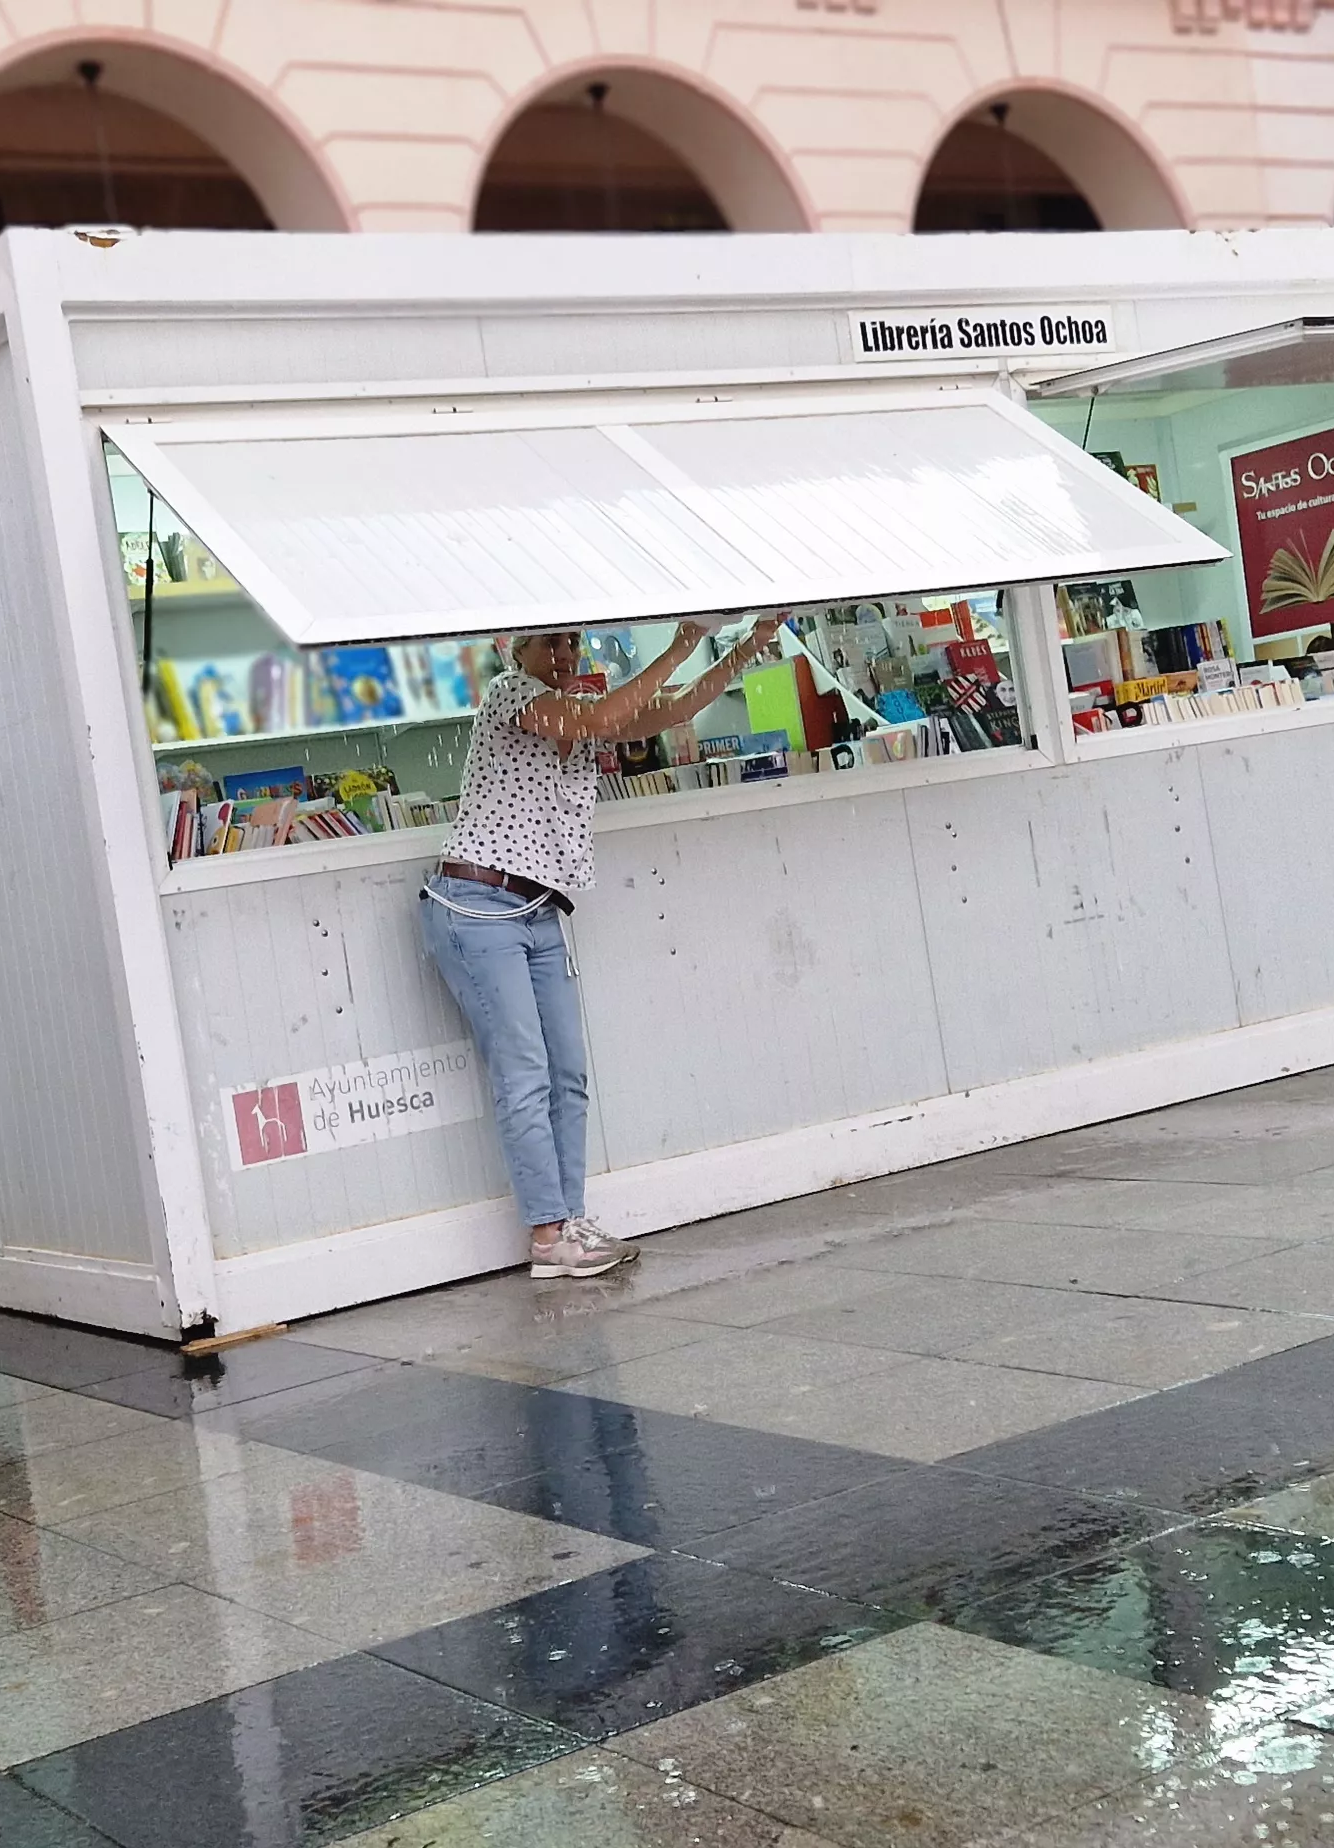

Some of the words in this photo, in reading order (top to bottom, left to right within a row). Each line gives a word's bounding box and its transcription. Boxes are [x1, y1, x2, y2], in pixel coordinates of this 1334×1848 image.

[860, 318, 953, 352] Librería
[957, 317, 1035, 348] Santos
[1040, 315, 1107, 345] Ochoa
[1256, 511, 1267, 520] Tu
[1267, 504, 1296, 519] espacio
[1297, 500, 1308, 510] de
[698, 737, 740, 754] PRIMER
[309, 1052, 468, 1104] Ayuntamiento
[313, 1109, 340, 1131] de
[348, 1090, 435, 1123] Huesca
